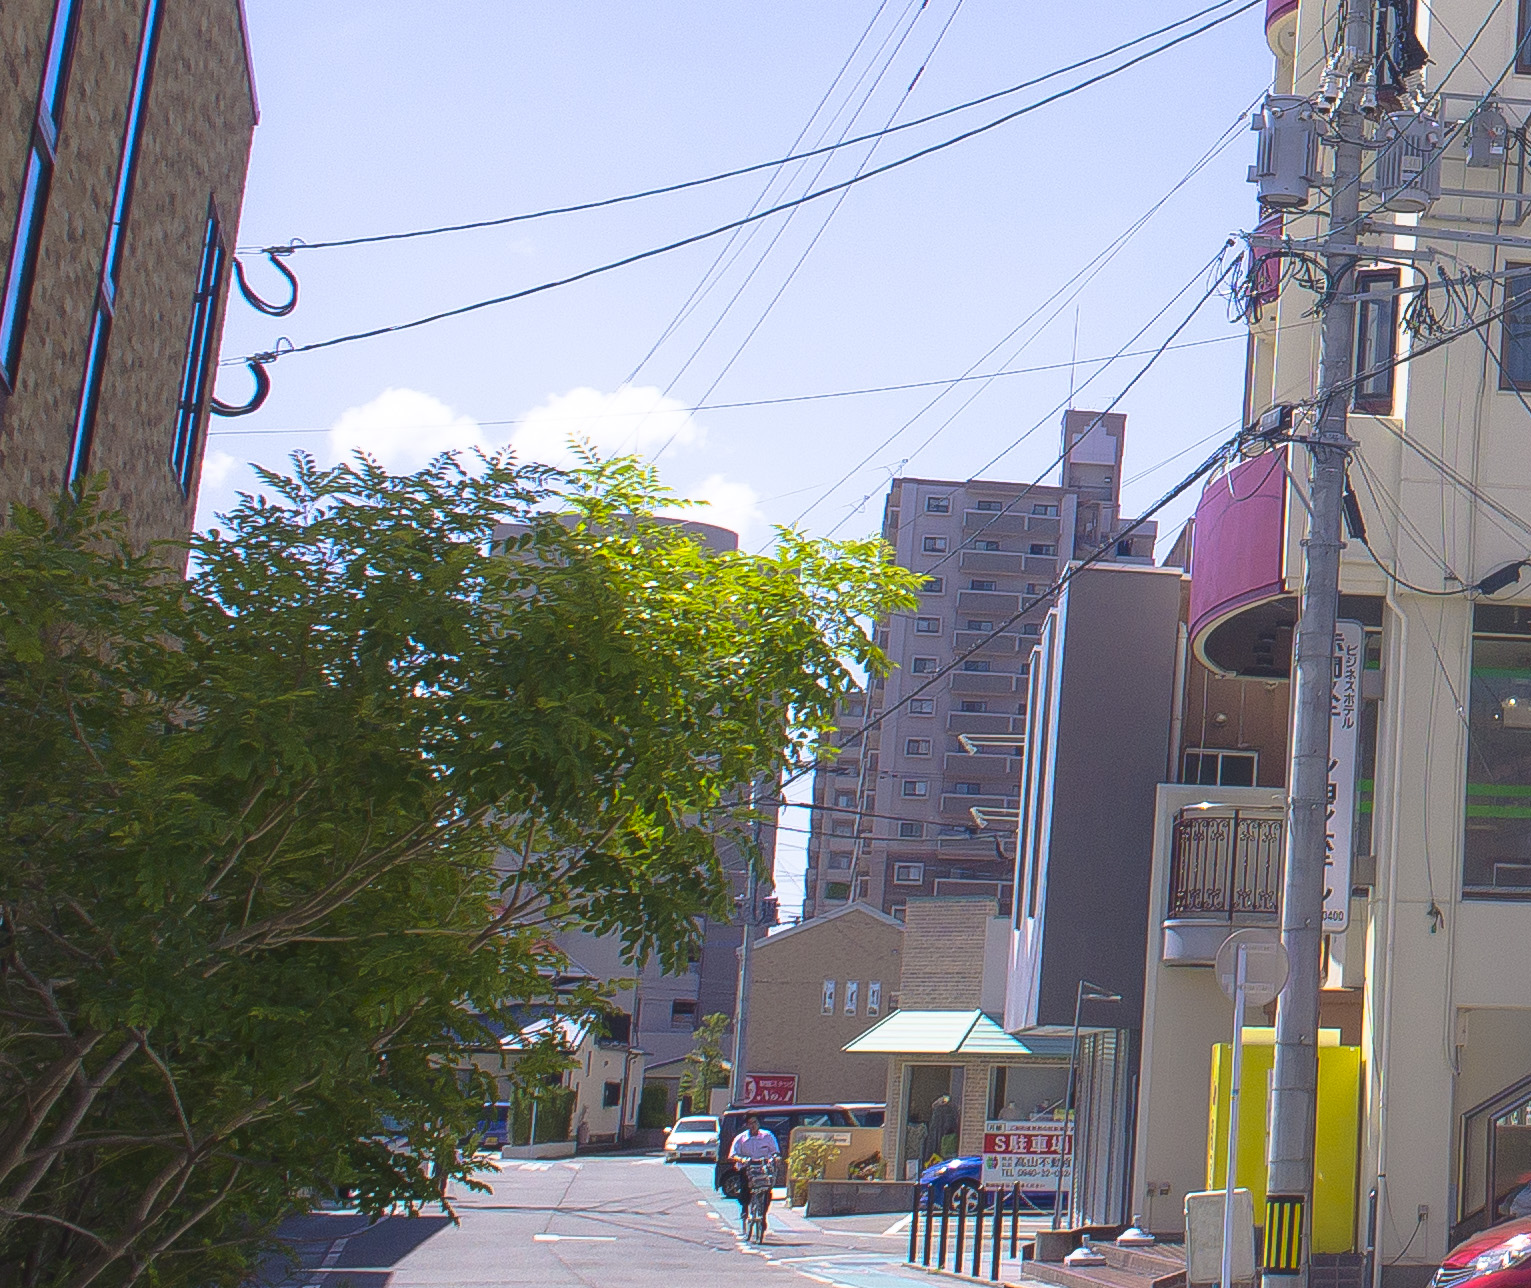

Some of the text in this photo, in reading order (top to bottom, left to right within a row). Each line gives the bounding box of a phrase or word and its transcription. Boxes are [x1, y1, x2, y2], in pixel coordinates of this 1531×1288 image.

[1342, 644, 1359, 729] ビジネスホテル
